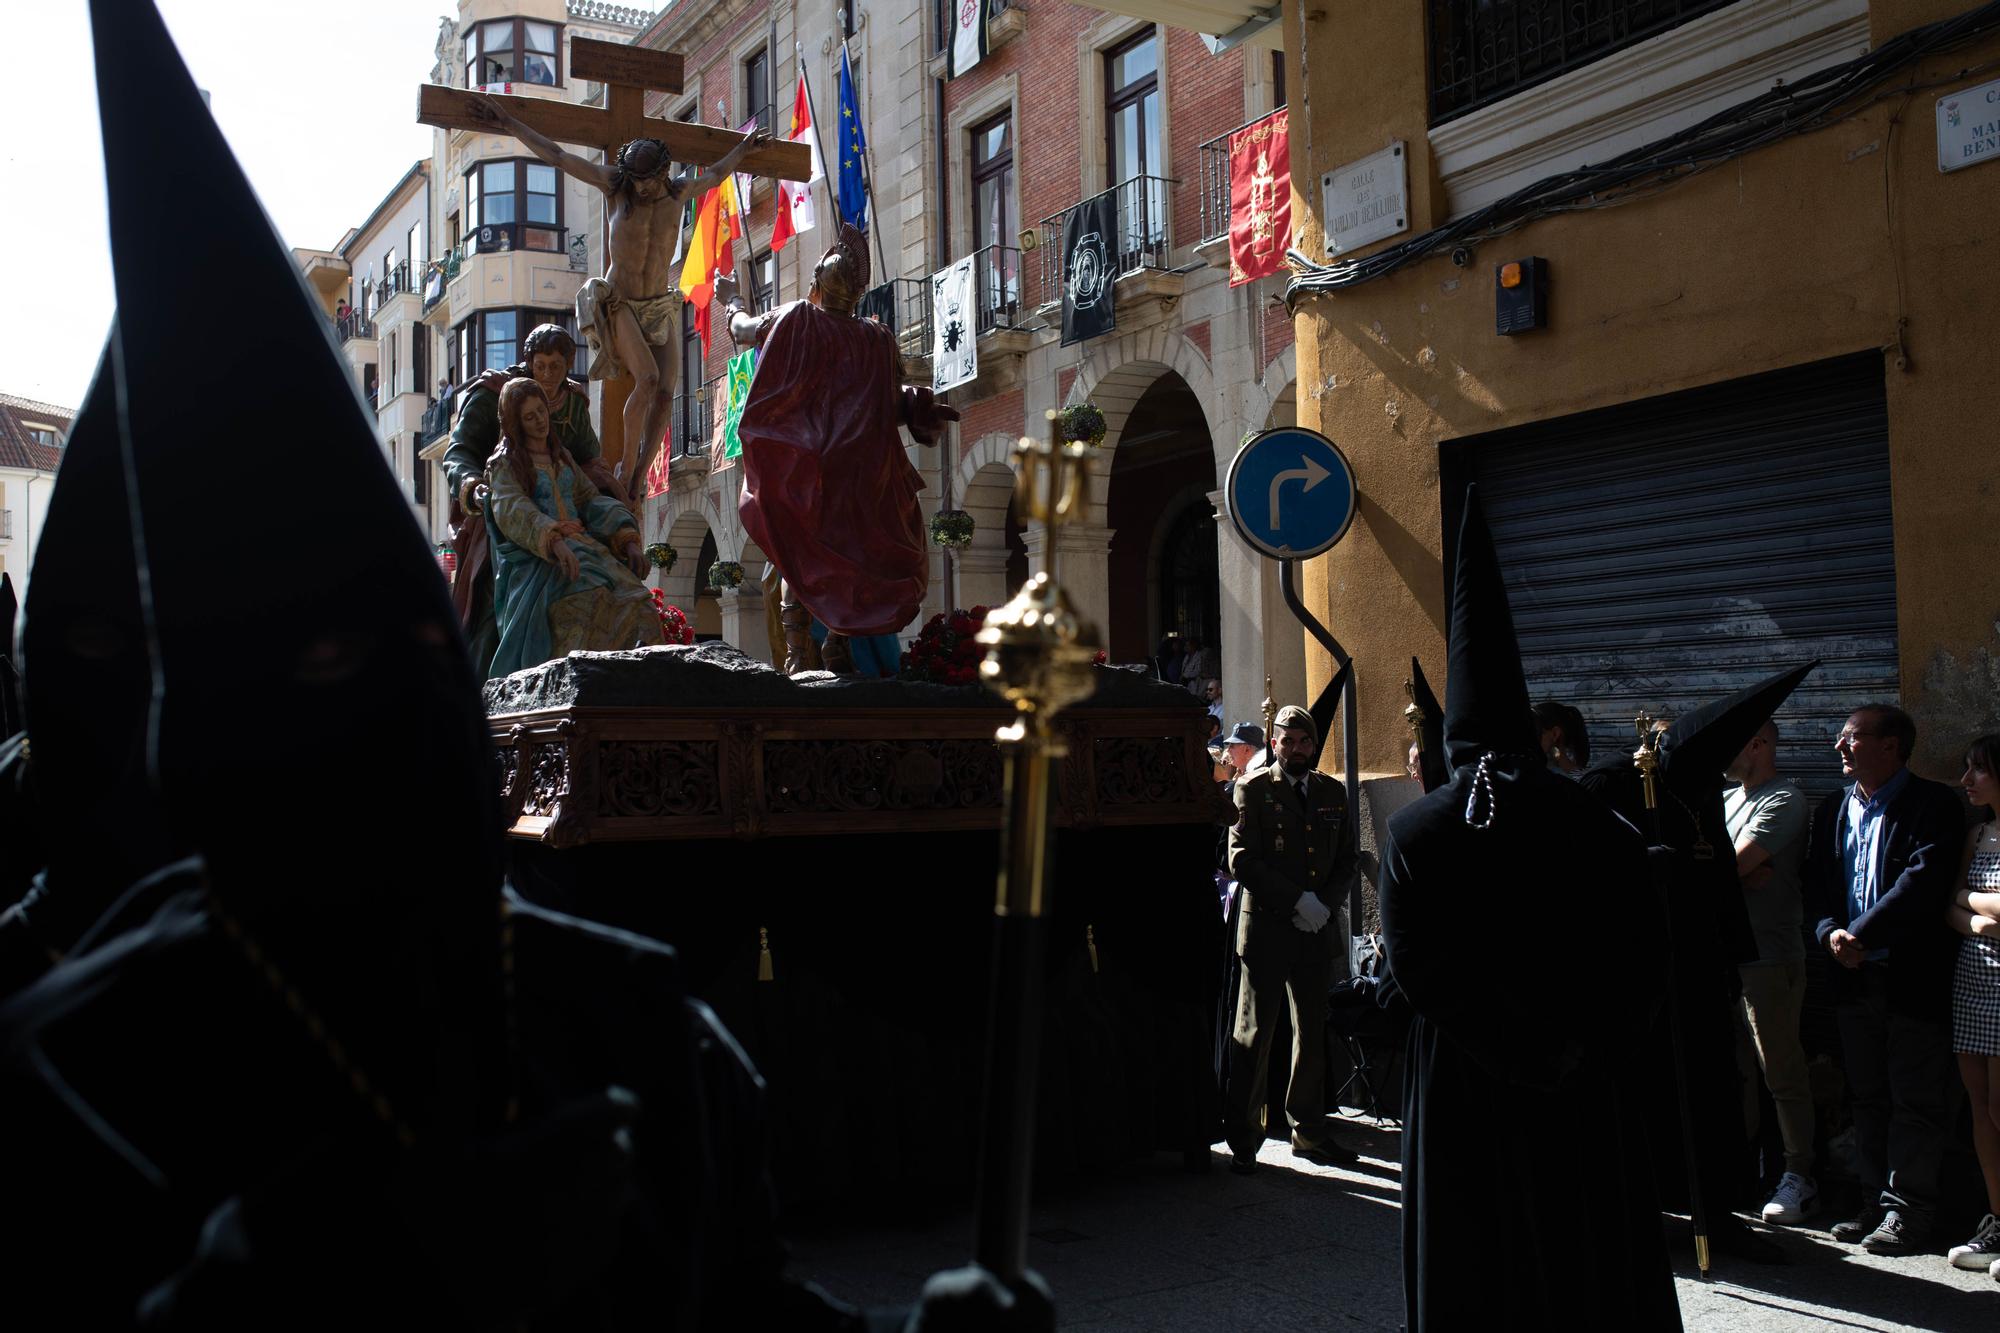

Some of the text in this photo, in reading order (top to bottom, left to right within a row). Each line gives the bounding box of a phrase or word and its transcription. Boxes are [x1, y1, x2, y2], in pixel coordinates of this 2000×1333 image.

[1986, 90, 2000, 103] C
[1972, 120, 2000, 139] MA
[1963, 135, 2000, 157] BEN
[1351, 168, 1375, 190] CALLE
[1356, 189, 1370, 204] DE
